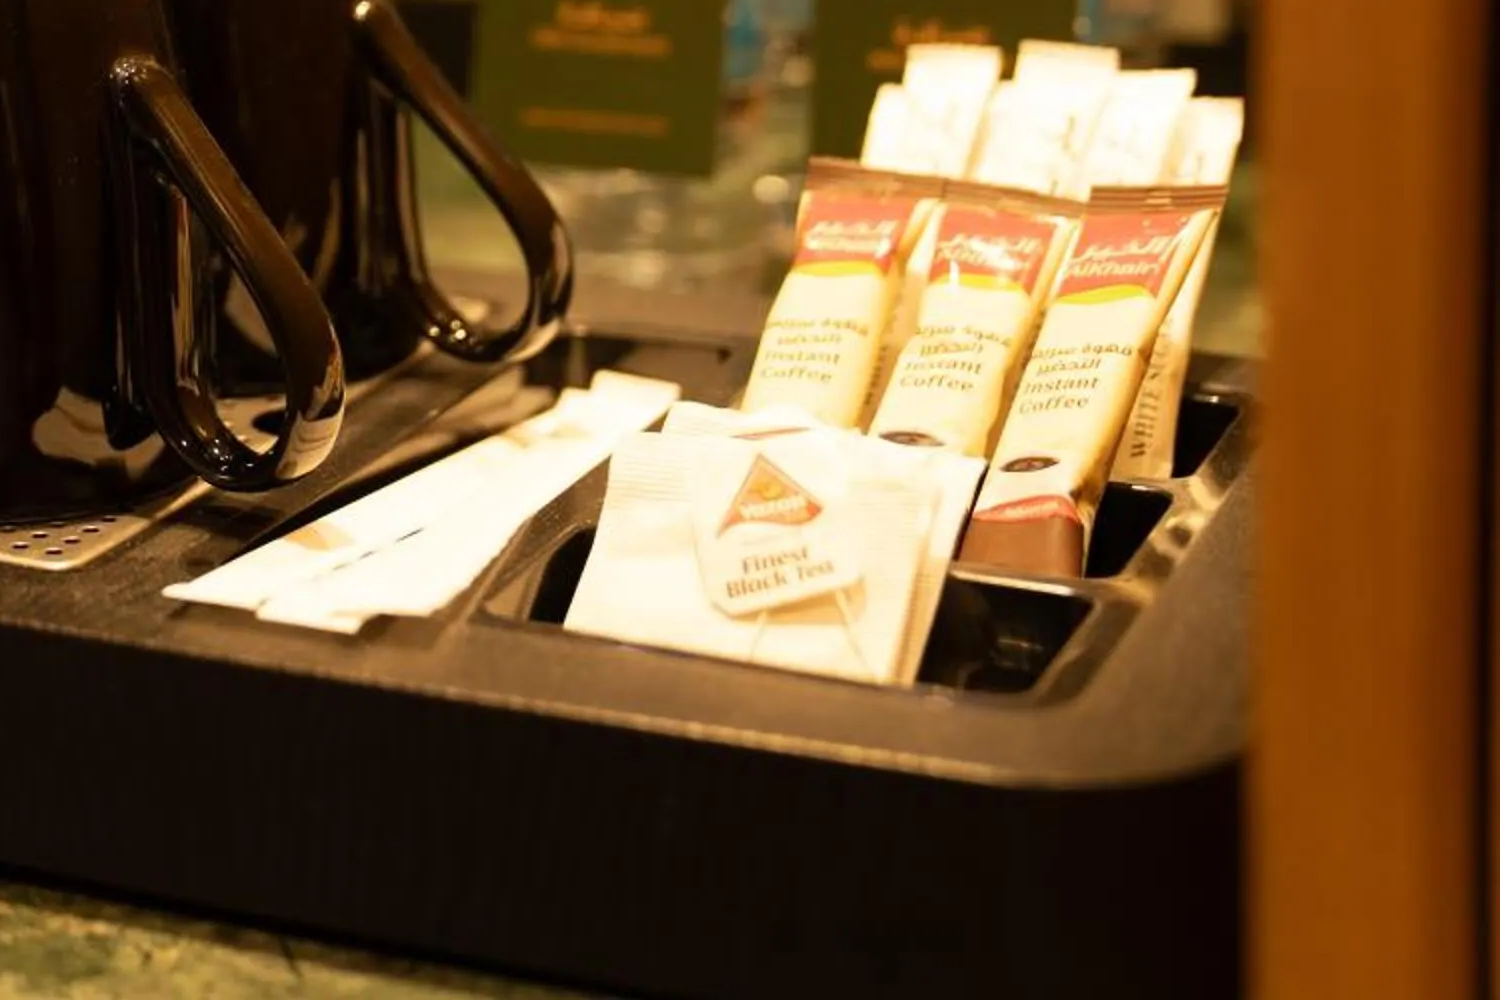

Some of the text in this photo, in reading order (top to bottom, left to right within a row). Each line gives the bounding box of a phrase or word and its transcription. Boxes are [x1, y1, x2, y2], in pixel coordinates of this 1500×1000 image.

[765, 351, 841, 366] Instant
[760, 366, 833, 384] Coffee
[905, 360, 983, 376] Instant
[900, 374, 975, 392] Coffee
[1023, 376, 1100, 396] Instant
[1019, 396, 1090, 415] Coffee
[741, 546, 809, 575] Finest
[726, 560, 835, 599] Black Tea
